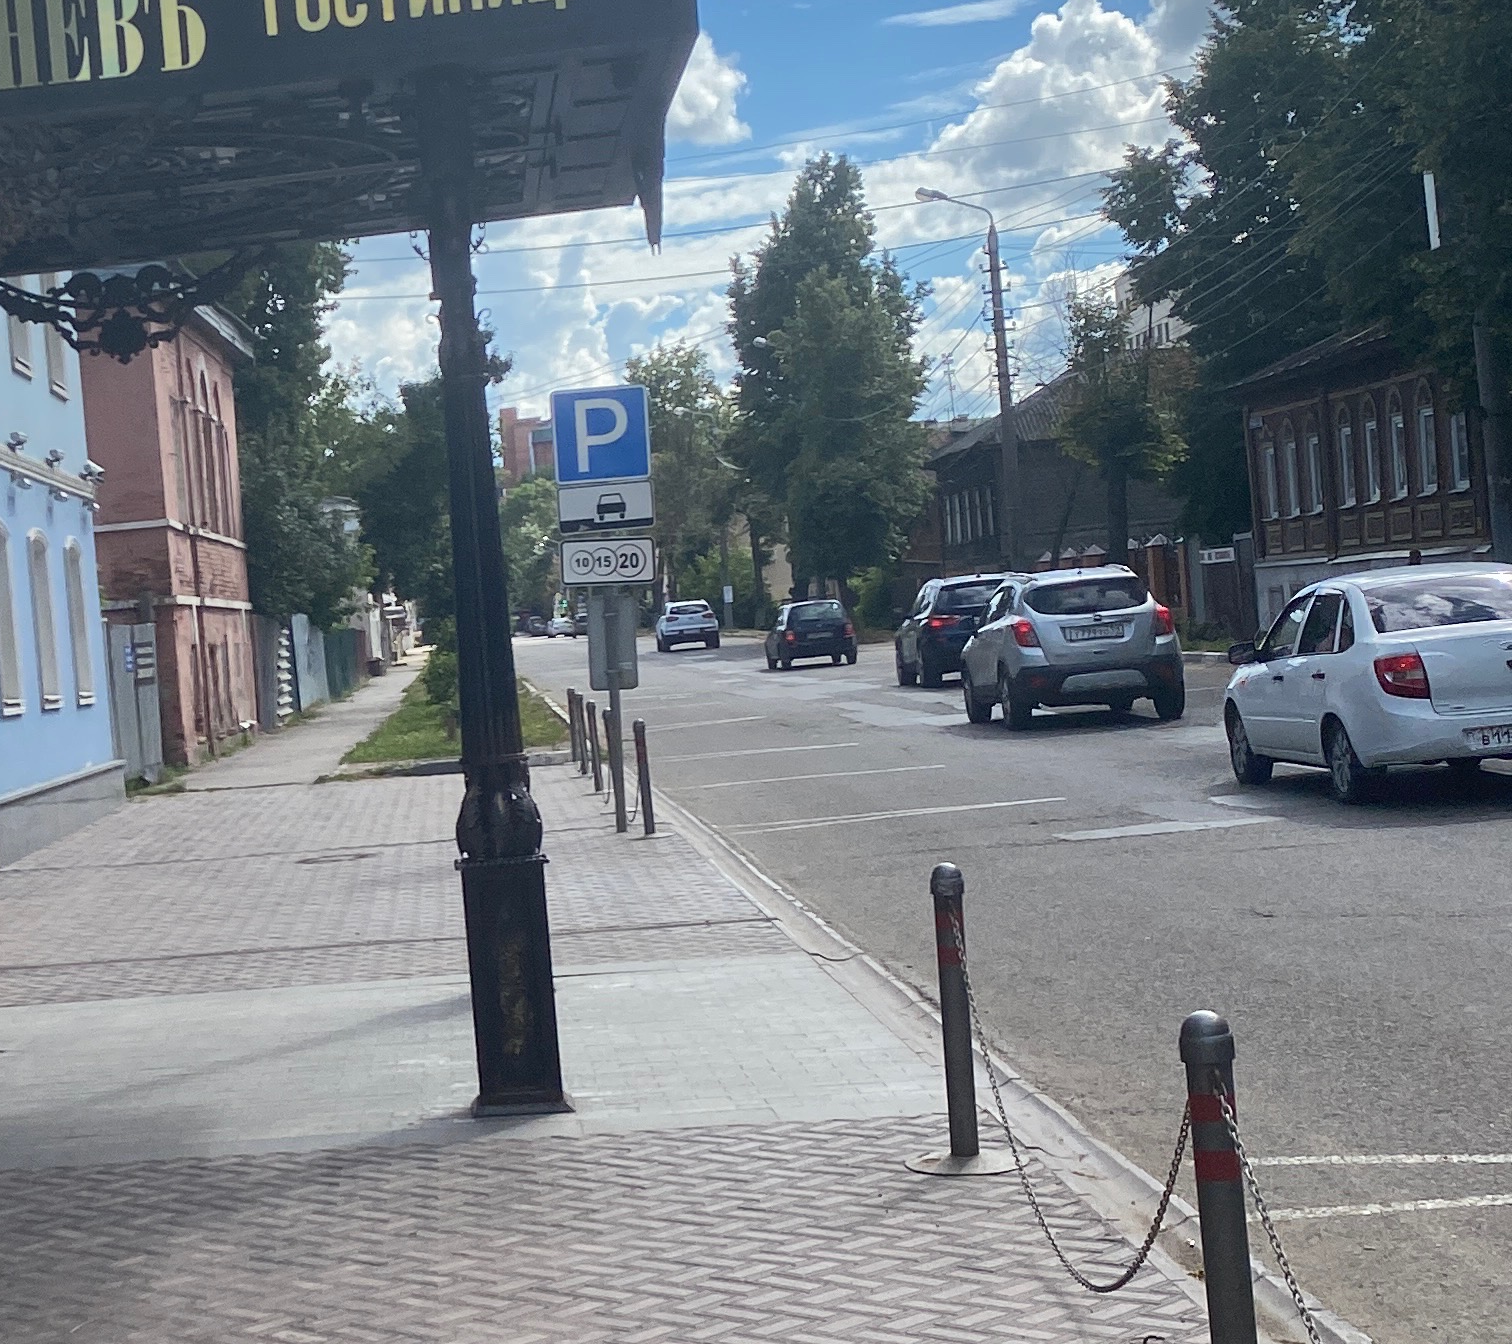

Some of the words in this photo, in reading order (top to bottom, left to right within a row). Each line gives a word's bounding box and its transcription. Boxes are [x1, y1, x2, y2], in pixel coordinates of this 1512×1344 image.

[573, 397, 628, 473] P
[575, 557, 589, 568] 10
[596, 556, 612, 568] 15
[619, 552, 639, 569] 20
